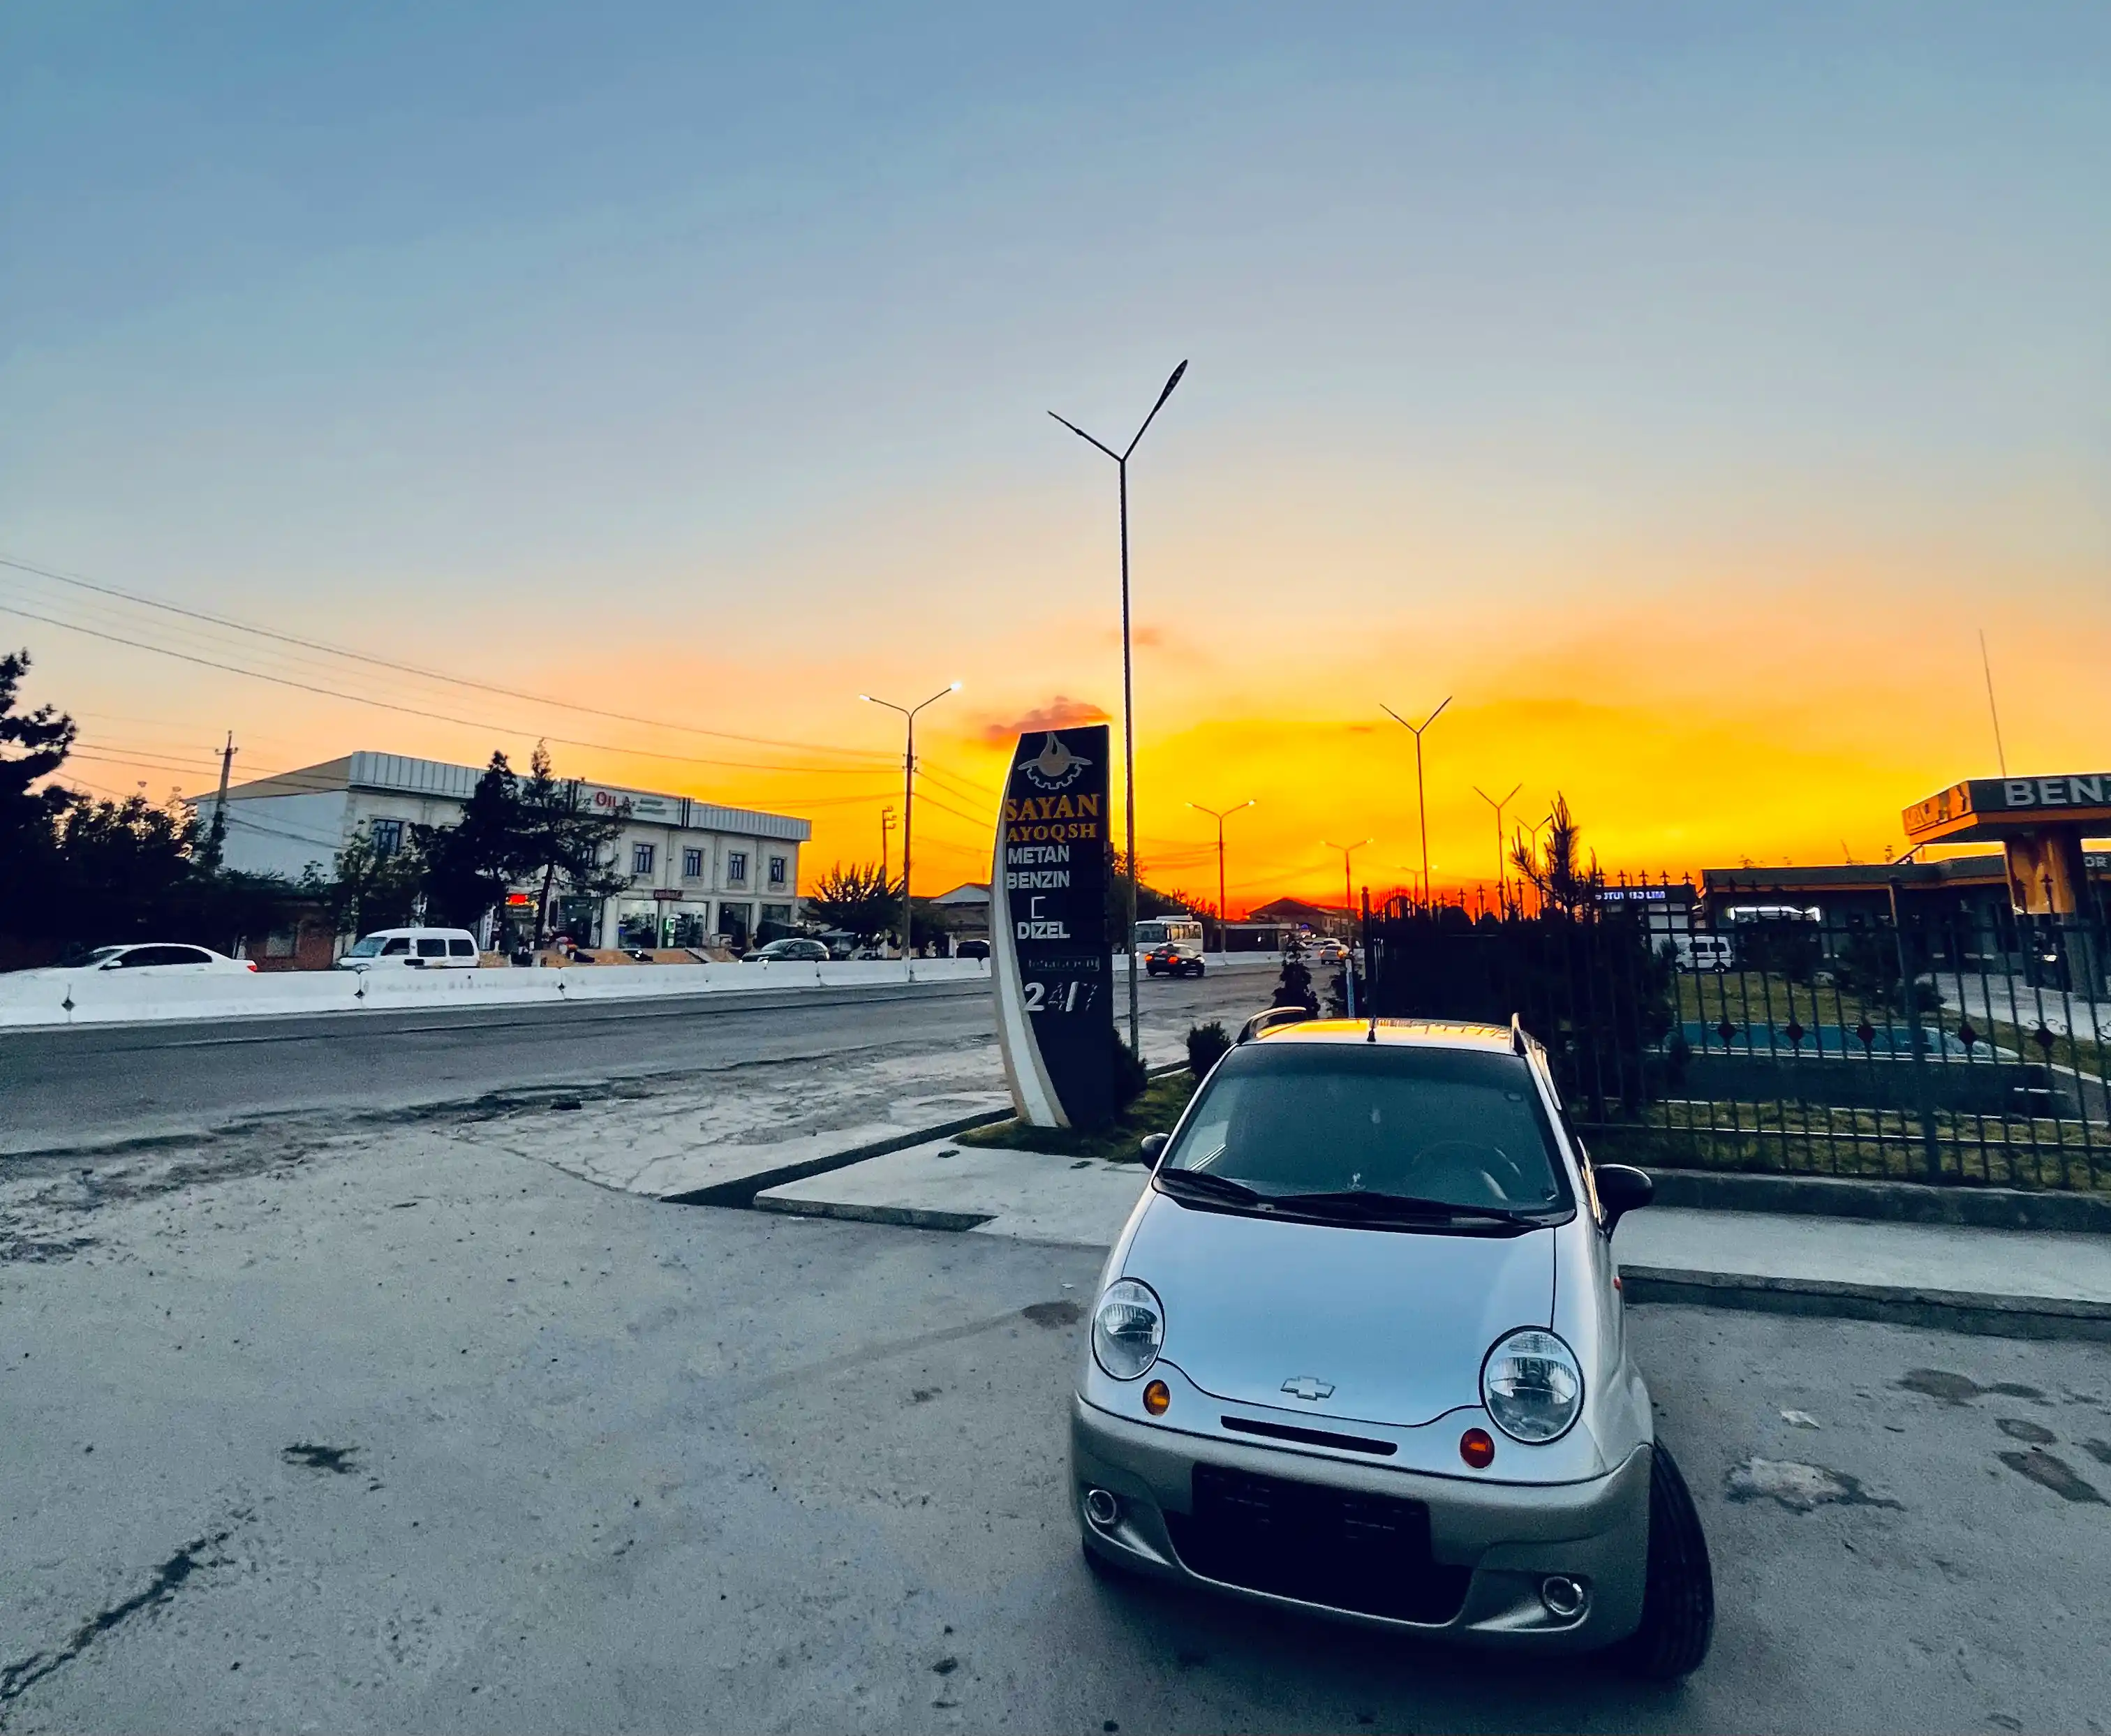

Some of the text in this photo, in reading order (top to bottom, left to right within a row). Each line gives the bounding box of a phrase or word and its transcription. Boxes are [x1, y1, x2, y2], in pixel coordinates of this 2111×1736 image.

[2003, 776, 2111, 806] BEN
[1005, 794, 1100, 822] SAYAN
[1006, 823, 1097, 843] AYOQSH
[1008, 845, 1069, 864] METAN
[1007, 870, 1070, 889] BENZIN
[1017, 921, 1070, 940] DIZEL
[1023, 981, 1098, 1012] 24/7
